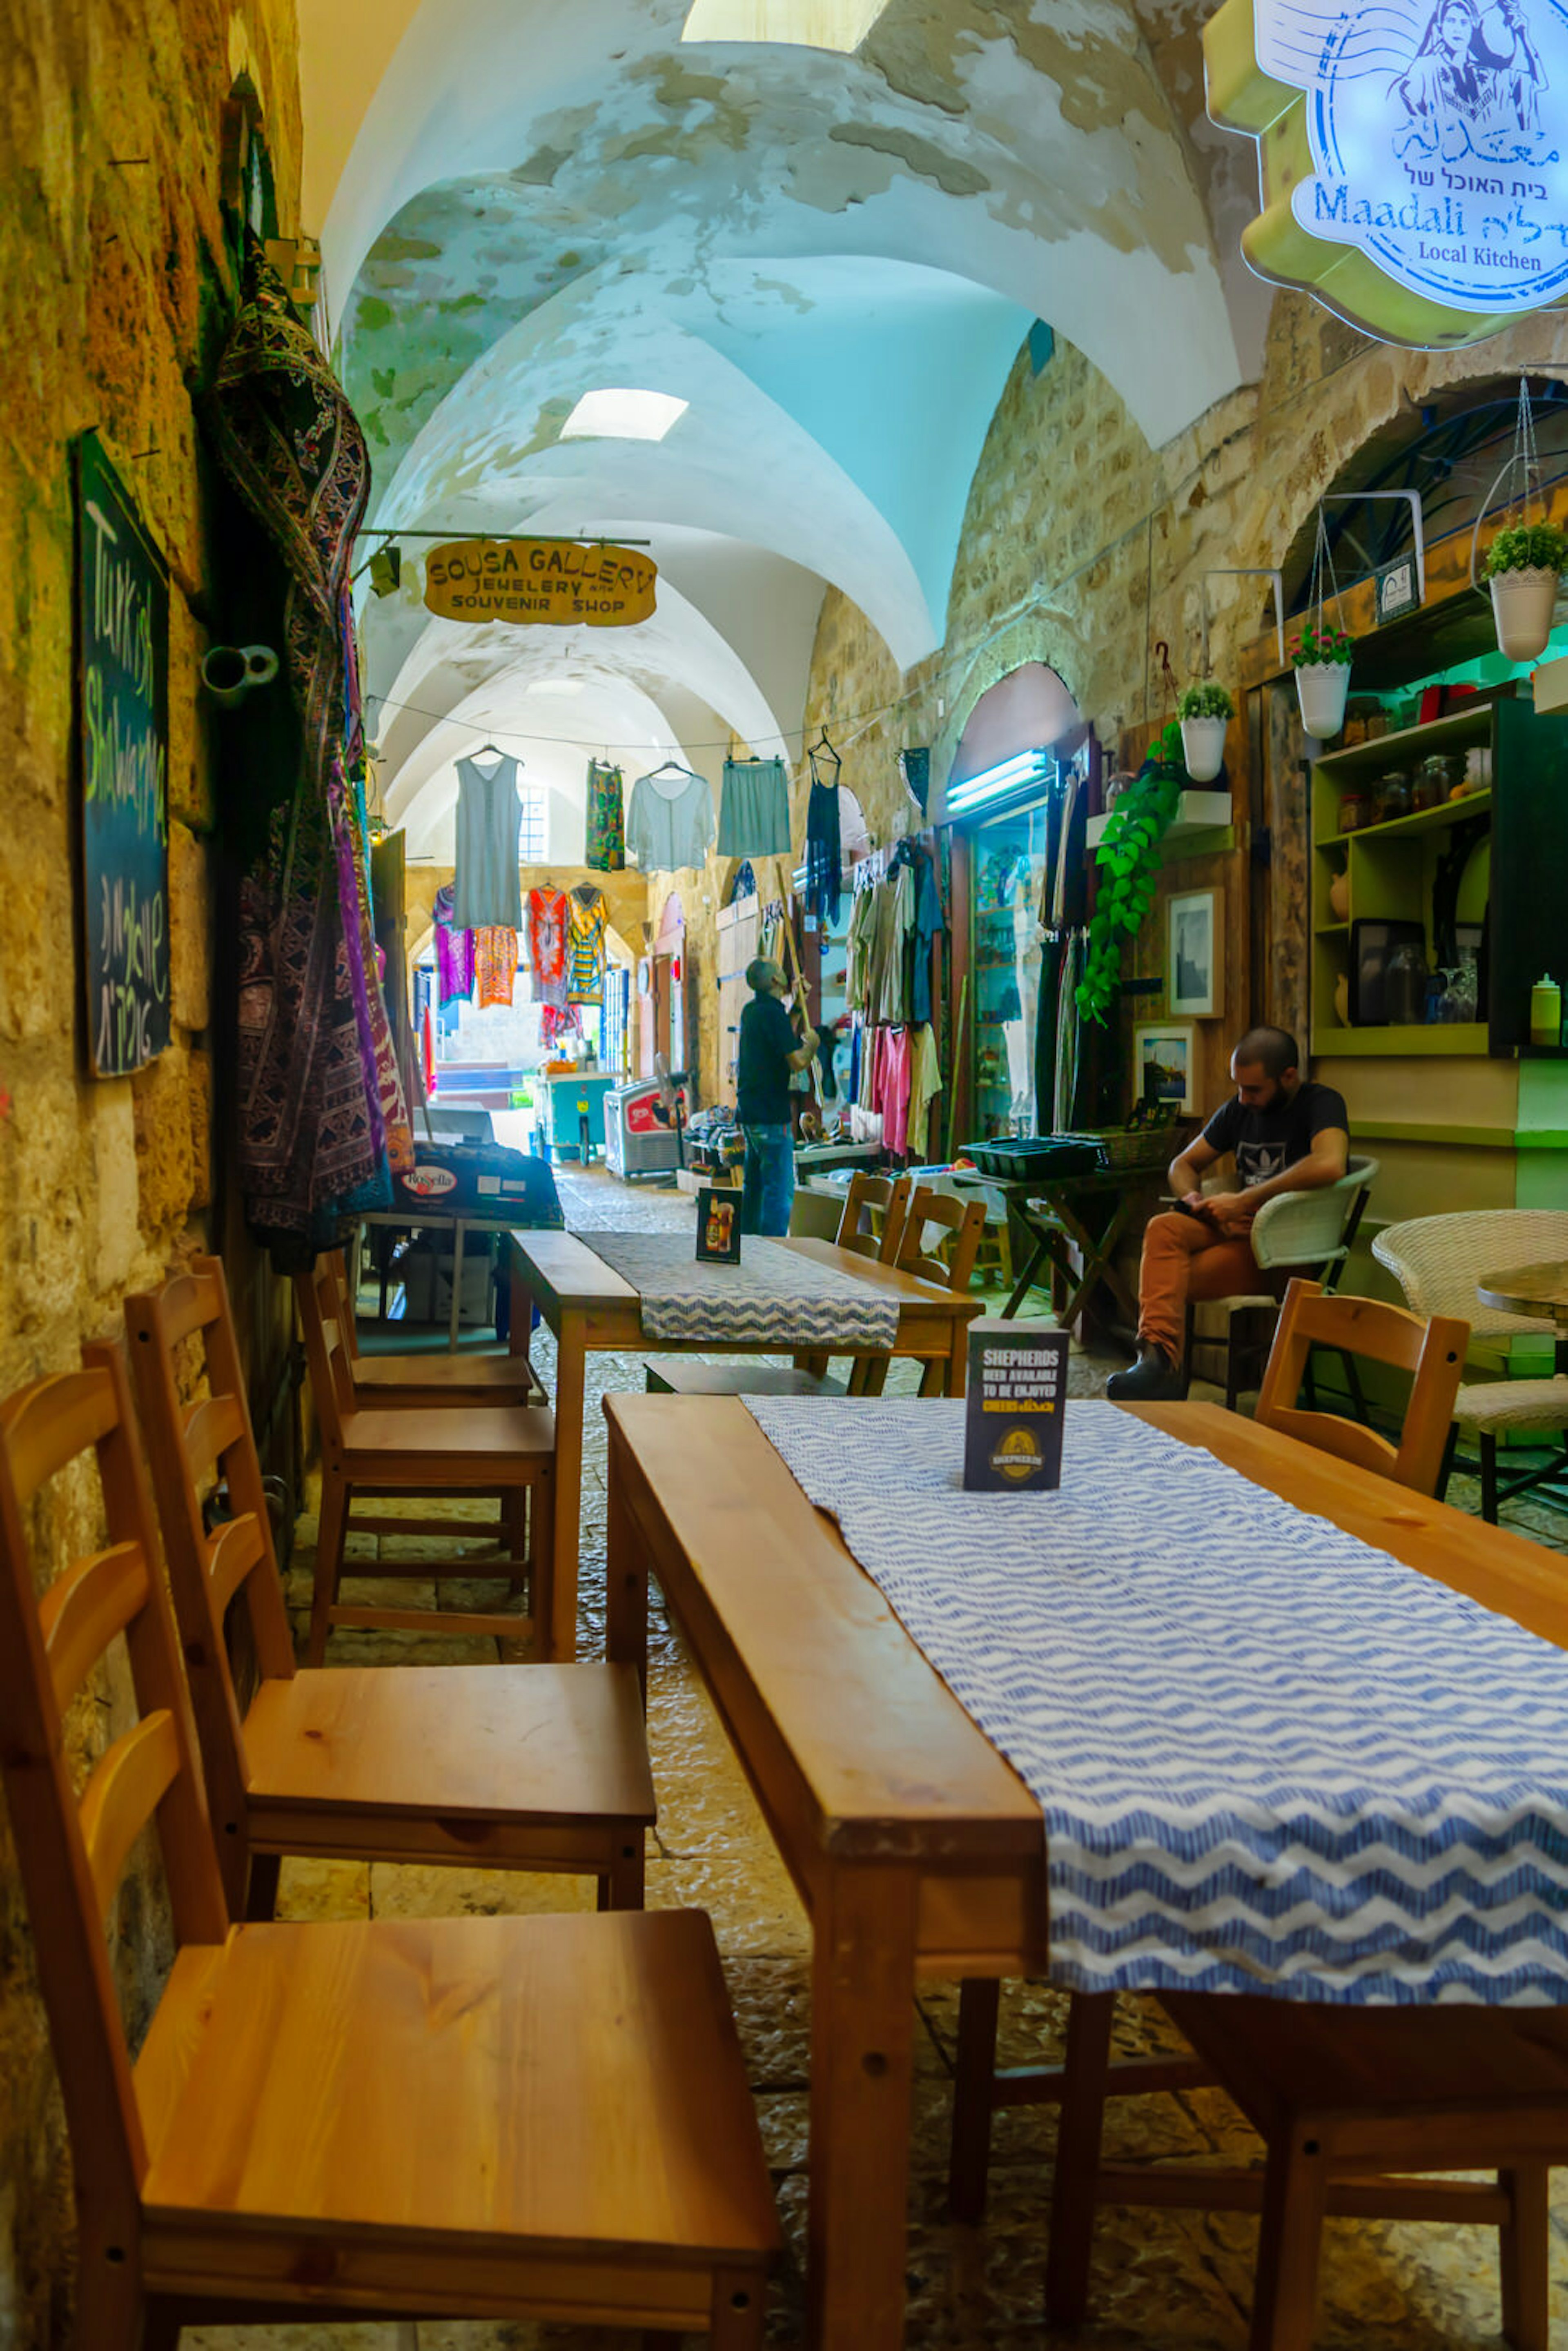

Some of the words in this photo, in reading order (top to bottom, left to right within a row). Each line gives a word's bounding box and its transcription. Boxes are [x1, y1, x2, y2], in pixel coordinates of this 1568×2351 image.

[1404, 163, 1434, 186] של
[1442, 167, 1503, 194] האוכל
[1511, 182, 1548, 200] בית
[1315, 182, 1467, 236] Maadali
[1482, 201, 1568, 247] דליה
[1418, 242, 1466, 263] Local
[1474, 247, 1541, 271] Kitchen
[430, 549, 518, 586] SOUSA
[530, 550, 653, 594] GALLERY
[473, 578, 582, 597] JEWELERY
[451, 594, 550, 610] SOUVENIR
[573, 599, 625, 612] SHOP
[983, 1349, 1059, 1367] SHEPHERDS
[983, 1384, 997, 1398] TO
[1014, 1384, 1057, 1398] ENJOYED
